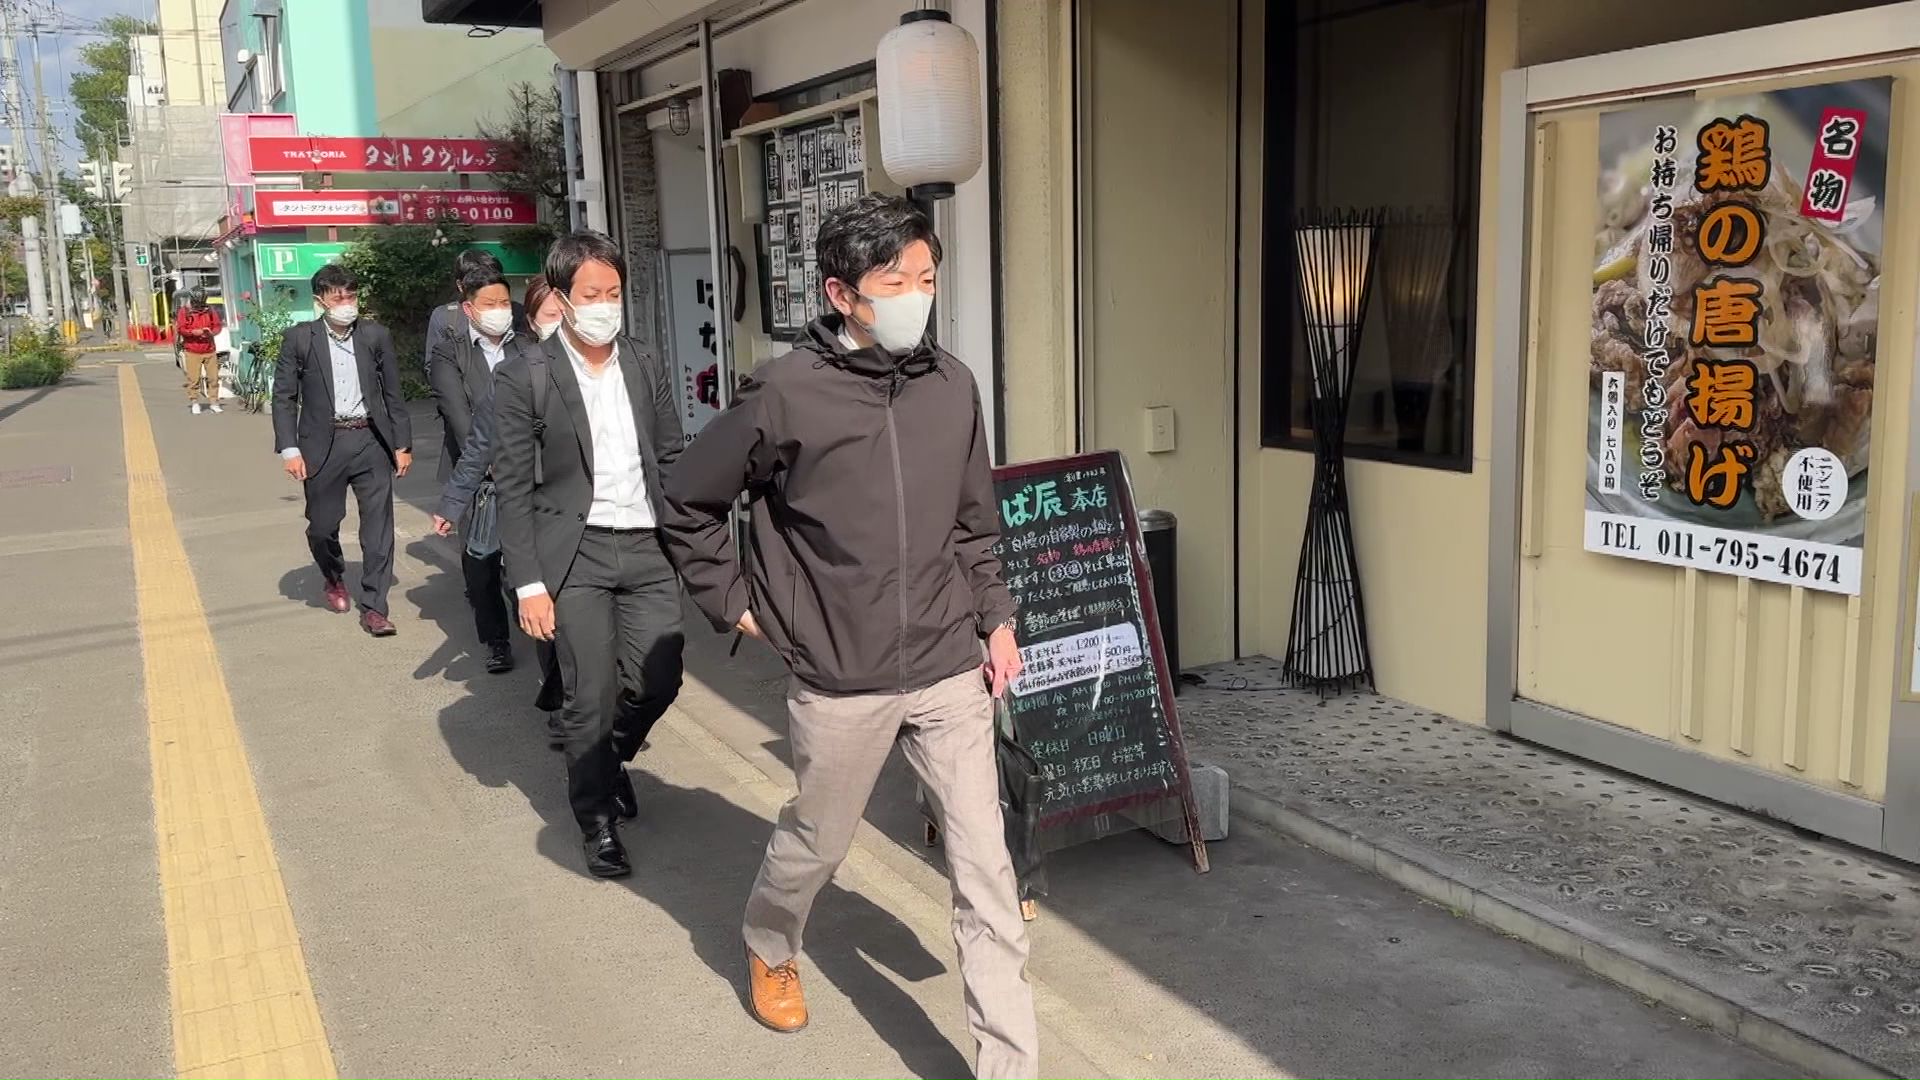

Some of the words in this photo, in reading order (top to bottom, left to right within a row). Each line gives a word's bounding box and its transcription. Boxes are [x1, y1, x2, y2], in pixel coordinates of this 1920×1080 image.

[1808, 115, 1857, 213] 名物
[274, 251, 293, 272] P
[1640, 124, 1678, 500] お持ち帰りだけでもどうぞ
[1685, 115, 1771, 510] 鶏の唐揚げ
[1069, 483, 1107, 512] 本店
[1796, 455, 1815, 512] 不使用
[1814, 456, 1833, 513] ニンニク
[1600, 520, 1641, 551] TEL
[1657, 528, 1842, 584] 011-795-4674
[1087, 724, 1126, 746] 日曜日
[1072, 755, 1101, 773] 祝日
